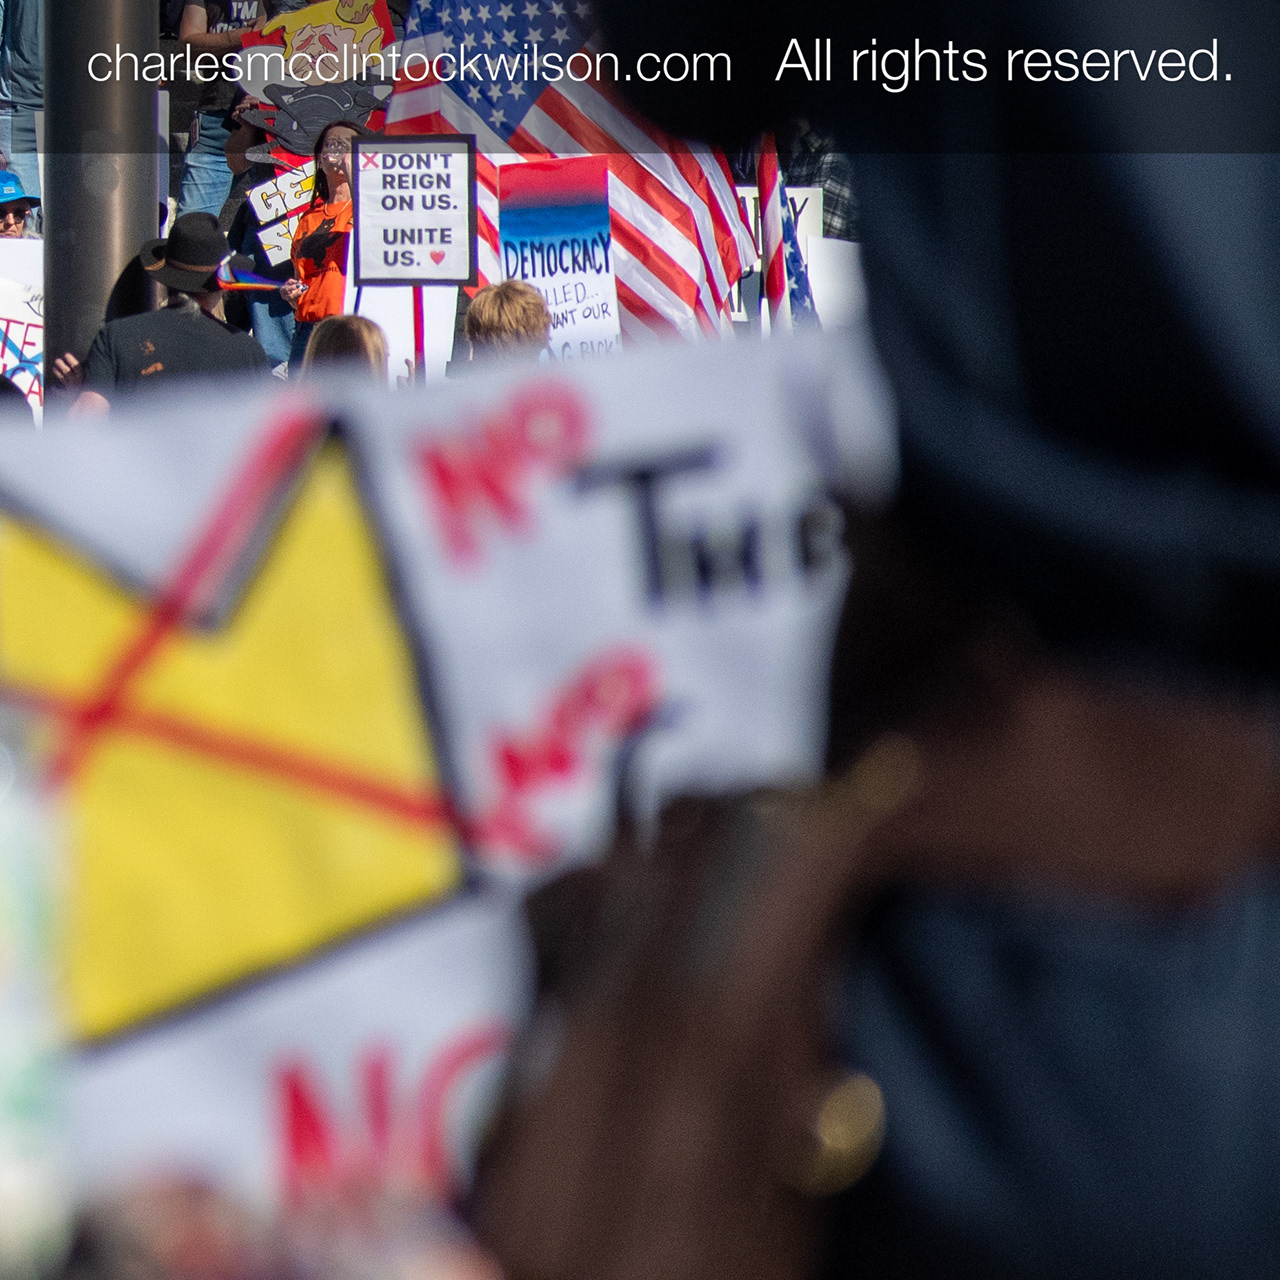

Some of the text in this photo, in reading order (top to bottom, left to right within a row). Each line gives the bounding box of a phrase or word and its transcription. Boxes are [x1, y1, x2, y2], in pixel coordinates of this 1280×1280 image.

[382, 154, 452, 170] DON'T
[382, 173, 452, 190] REIGN
[381, 194, 458, 211] ON US.
[383, 228, 452, 245] UNITE
[383, 251, 421, 267] US.
[503, 232, 612, 280] DEMOCRACY
